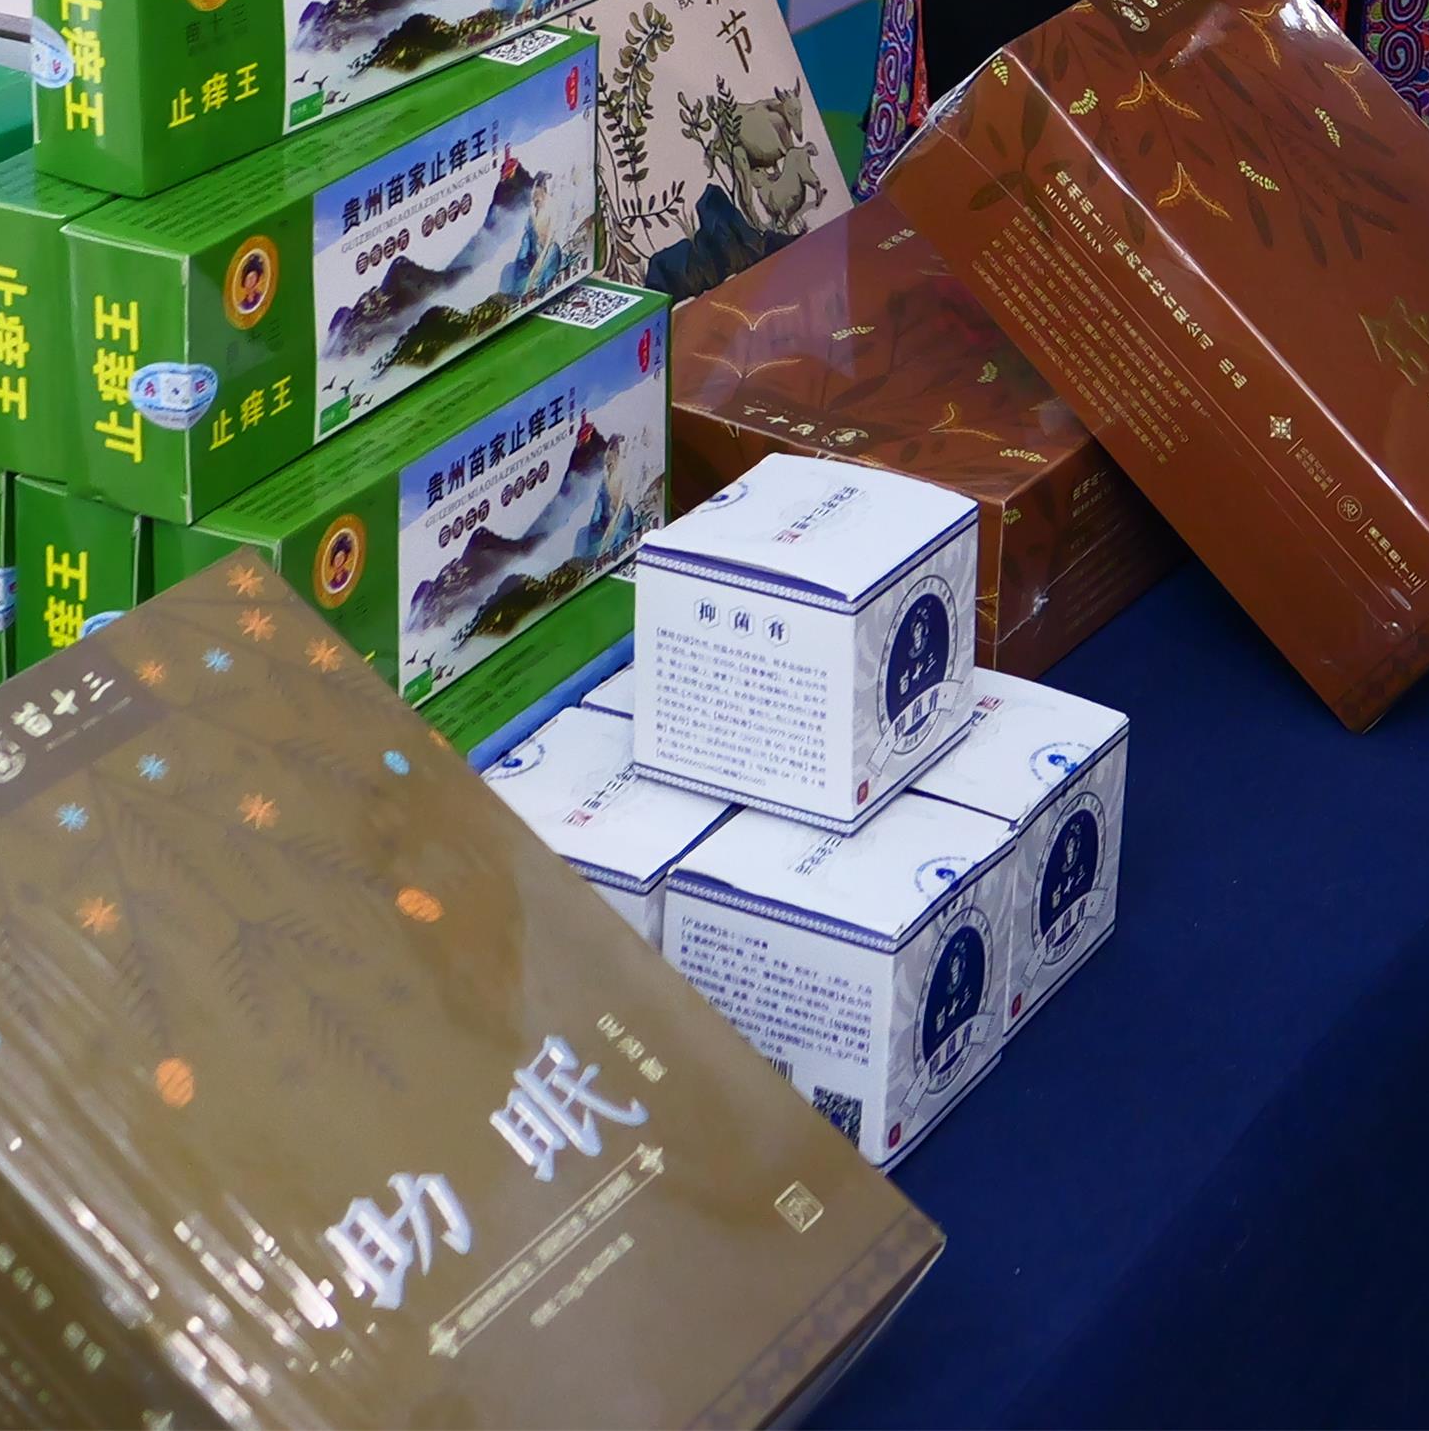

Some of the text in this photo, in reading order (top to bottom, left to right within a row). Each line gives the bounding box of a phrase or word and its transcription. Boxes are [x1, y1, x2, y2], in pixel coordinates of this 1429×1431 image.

[168, 61, 260, 129] 止痒王
[341, 126, 489, 234] 贵州苗家止痒王
[1043, 182, 1105, 255] MIAO SHI SAN
[92, 294, 143, 464] 止痒王
[208, 375, 293, 452] 止痒王
[425, 393, 566, 510] 贵州苗家止痒王
[10, 670, 116, 738] 苗十三
[898, 652, 938, 696] 苗十三
[1050, 865, 1087, 910] 苗十三
[935, 988, 973, 1033] 苗十三
[324, 1034, 649, 1310] 助眠
